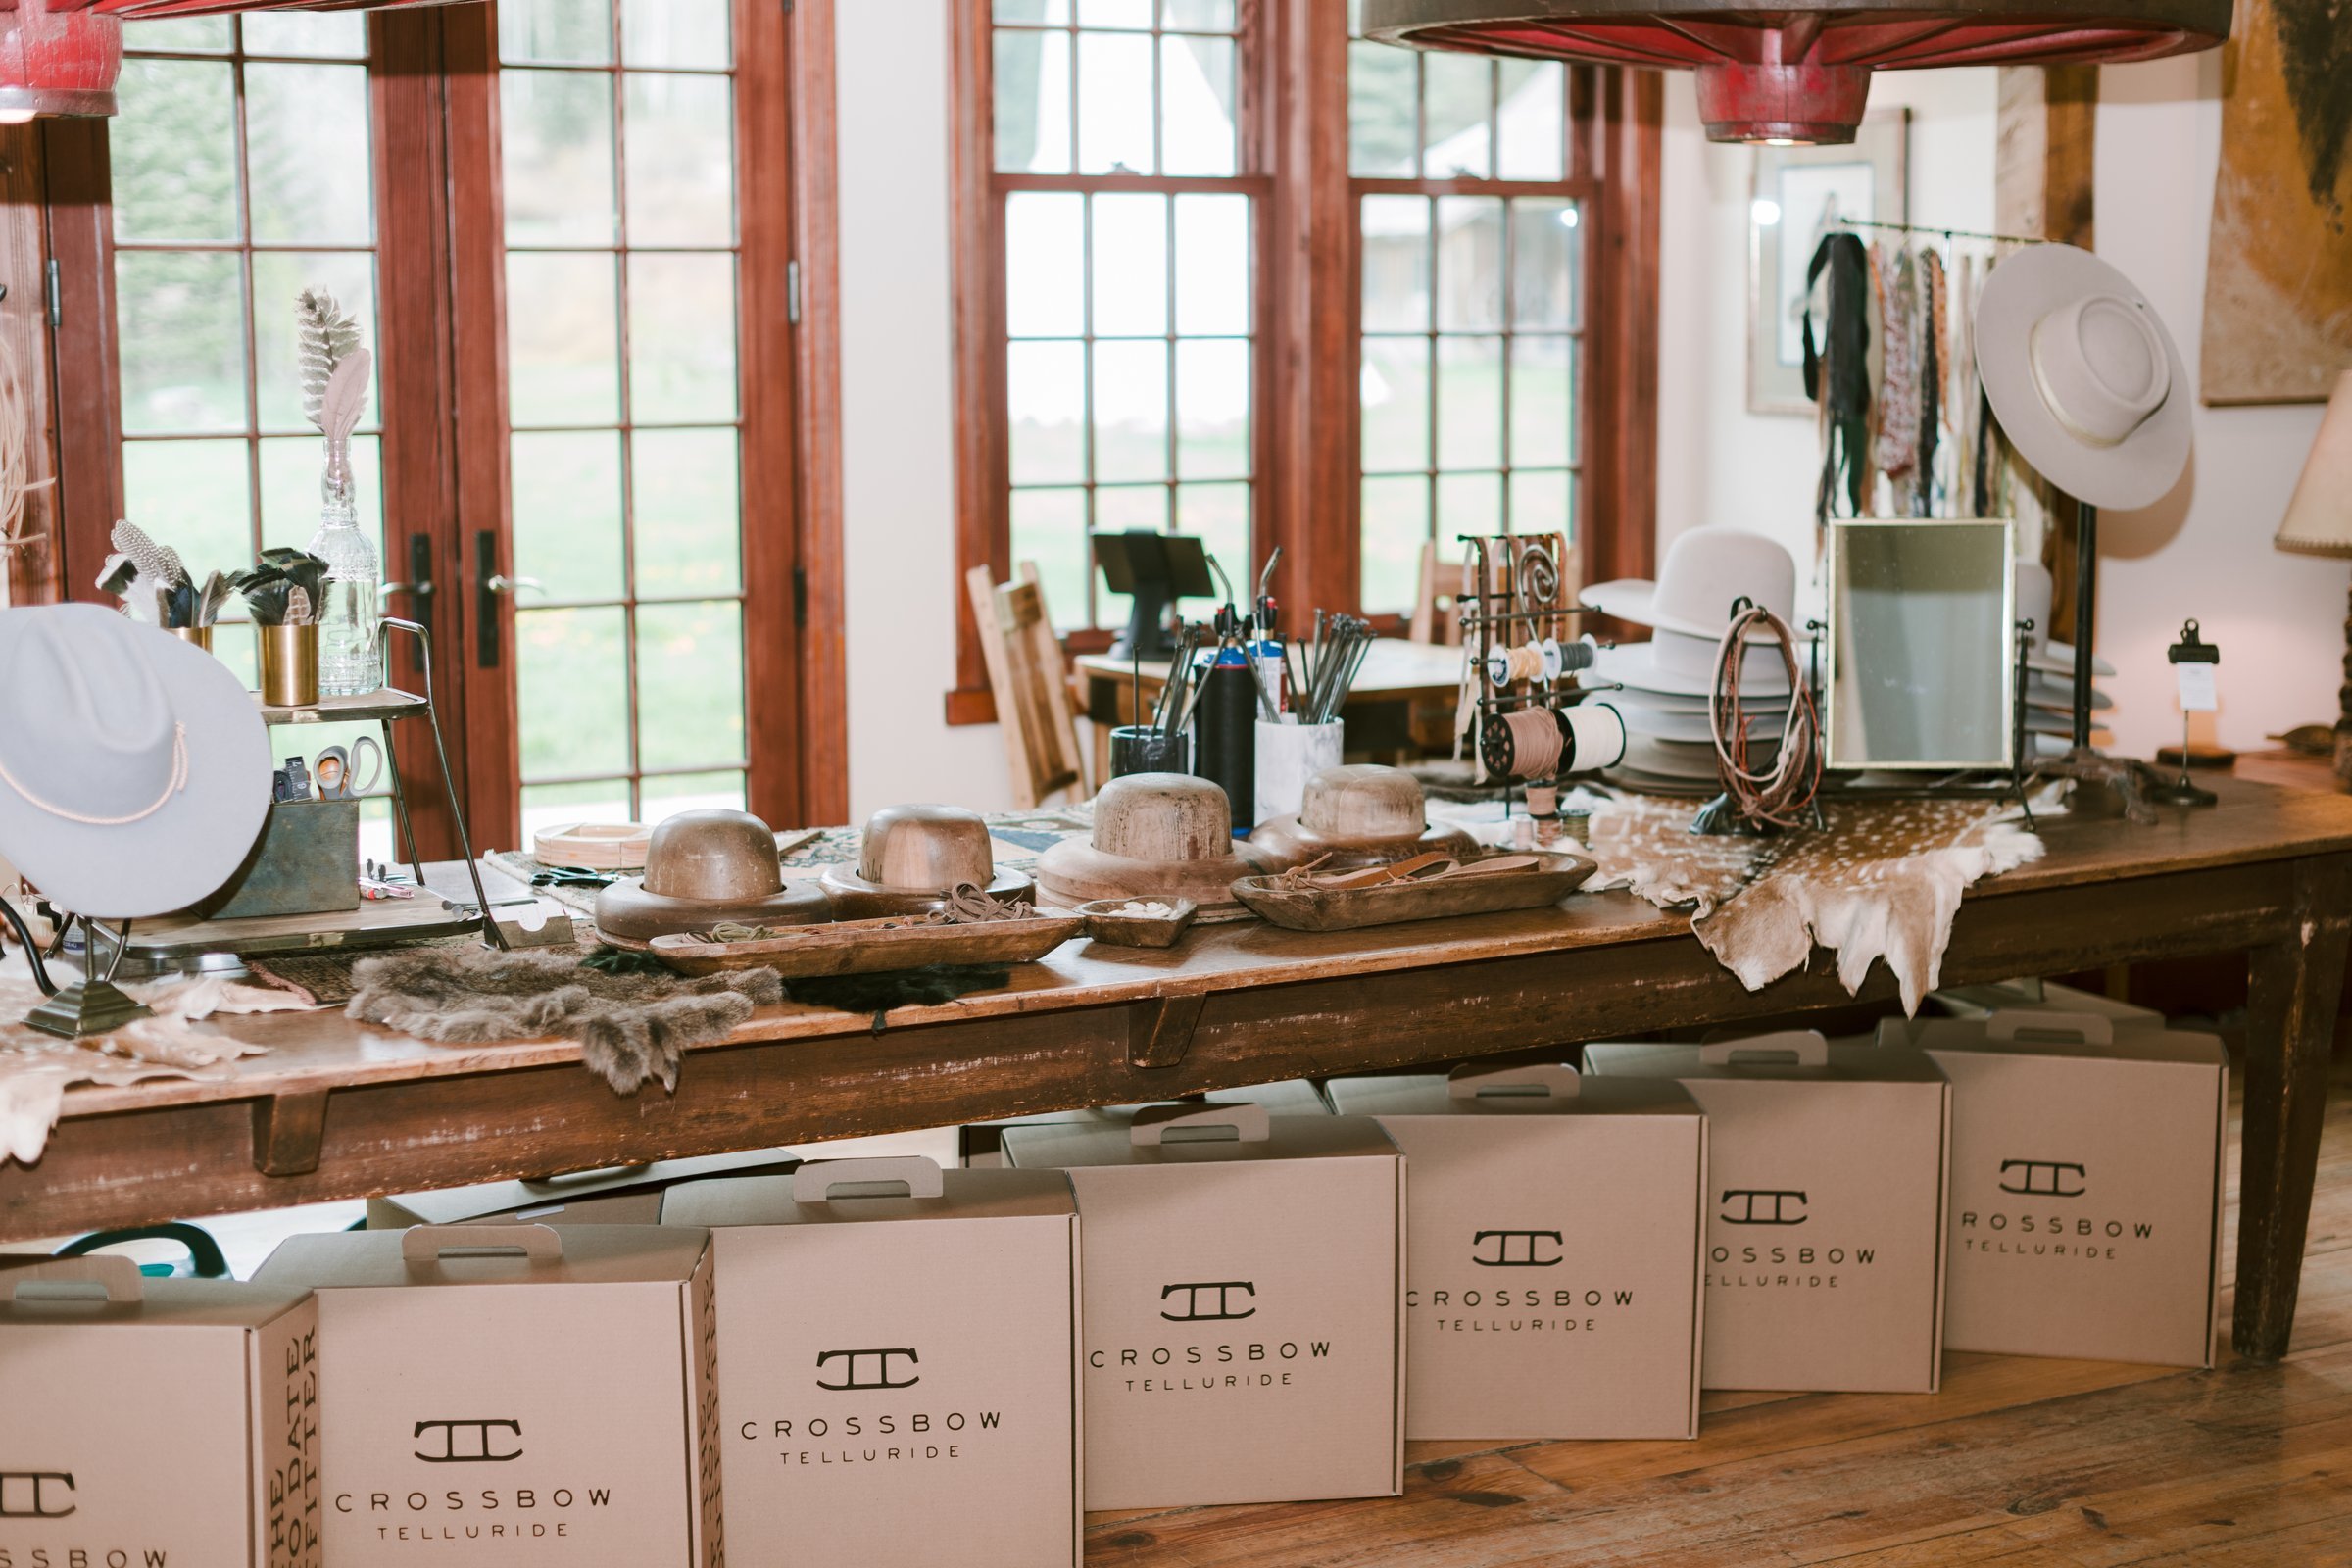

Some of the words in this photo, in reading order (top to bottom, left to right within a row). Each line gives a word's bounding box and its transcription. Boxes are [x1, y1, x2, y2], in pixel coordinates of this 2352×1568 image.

[1962, 1211, 2152, 1239] ROSSBOW
[1711, 1246, 1875, 1264] OSSBOW
[1965, 1239, 2116, 1259] TELLURIDE
[1705, 1274, 1838, 1288] ELLURIDE
[1406, 1290, 1633, 1307] CROSSBOW
[1438, 1319, 1595, 1332] TELLURIDE
[1090, 1341, 1330, 1368] CROSSBOW
[1125, 1373, 1292, 1392] TELLURIDE
[287, 1338, 300, 1497] DATE
[741, 1411, 1001, 1440] CROSSBOW
[304, 1325, 317, 1568] FITTER
[780, 1446, 959, 1465] TELLURIDE
[335, 1488, 611, 1513] CROSSBOW
[377, 1523, 568, 1541] TELLURIDE
[0, 1548, 167, 1568] SSBOW
